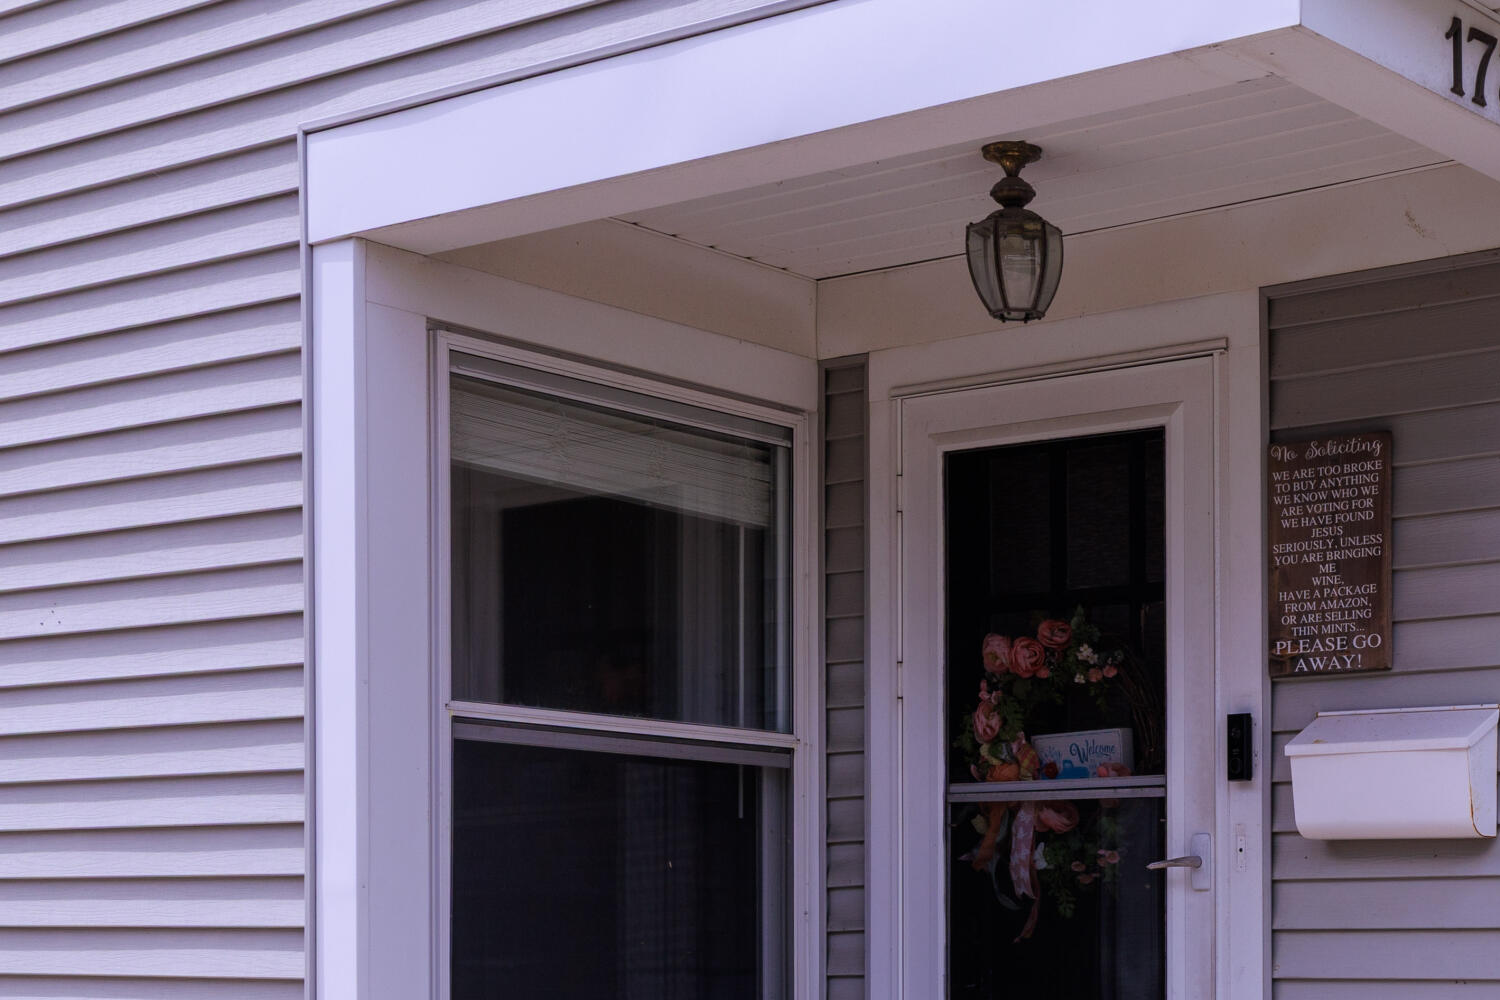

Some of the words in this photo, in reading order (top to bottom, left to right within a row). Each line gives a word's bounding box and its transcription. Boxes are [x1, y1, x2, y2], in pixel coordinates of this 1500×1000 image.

[1271, 445, 1298, 462] No
[1305, 437, 1383, 459] Soliciting
[1272, 471, 1290, 481] WE
[1292, 468, 1315, 480] ARE
[1317, 465, 1340, 477] TOO
[1343, 460, 1383, 474] BROKE
[1275, 483, 1290, 493] TO
[1293, 480, 1316, 491] BUY
[1320, 473, 1379, 489] ANYTHING
[1273, 496, 1291, 505] WE
[1294, 491, 1328, 504] KNOW
[1331, 487, 1358, 499] WHO
[1361, 485, 1379, 496] WE
[1281, 506, 1303, 517] ARE
[1306, 501, 1349, 513] VOTING
[1352, 498, 1374, 509] FOR
[1281, 519, 1299, 529] WE
[1301, 515, 1332, 527] HAVE
[1335, 510, 1374, 523] FOUND
[1311, 526, 1343, 538] JESUS
[1340, 534, 1383, 547] UNLESS
[1275, 554, 1298, 566] YOU
[1301, 552, 1324, 563] ARE
[1326, 546, 1381, 561] BRINGING
[1320, 563, 1336, 573] ME
[1279, 590, 1310, 601] HAVE
[1313, 589, 1320, 598] A
[1324, 584, 1377, 598] PACKAGE
[1281, 615, 1297, 625] OR
[1300, 613, 1322, 624] ARE
[1325, 609, 1372, 622] SELLING
[1285, 602, 1316, 613] FROM
[1291, 626, 1319, 637] THIN
[1276, 636, 1348, 655] PLEASE
[1352, 633, 1382, 649] GO
[1294, 654, 1362, 672] AWAY!
[1069, 739, 1115, 764] Welcome
